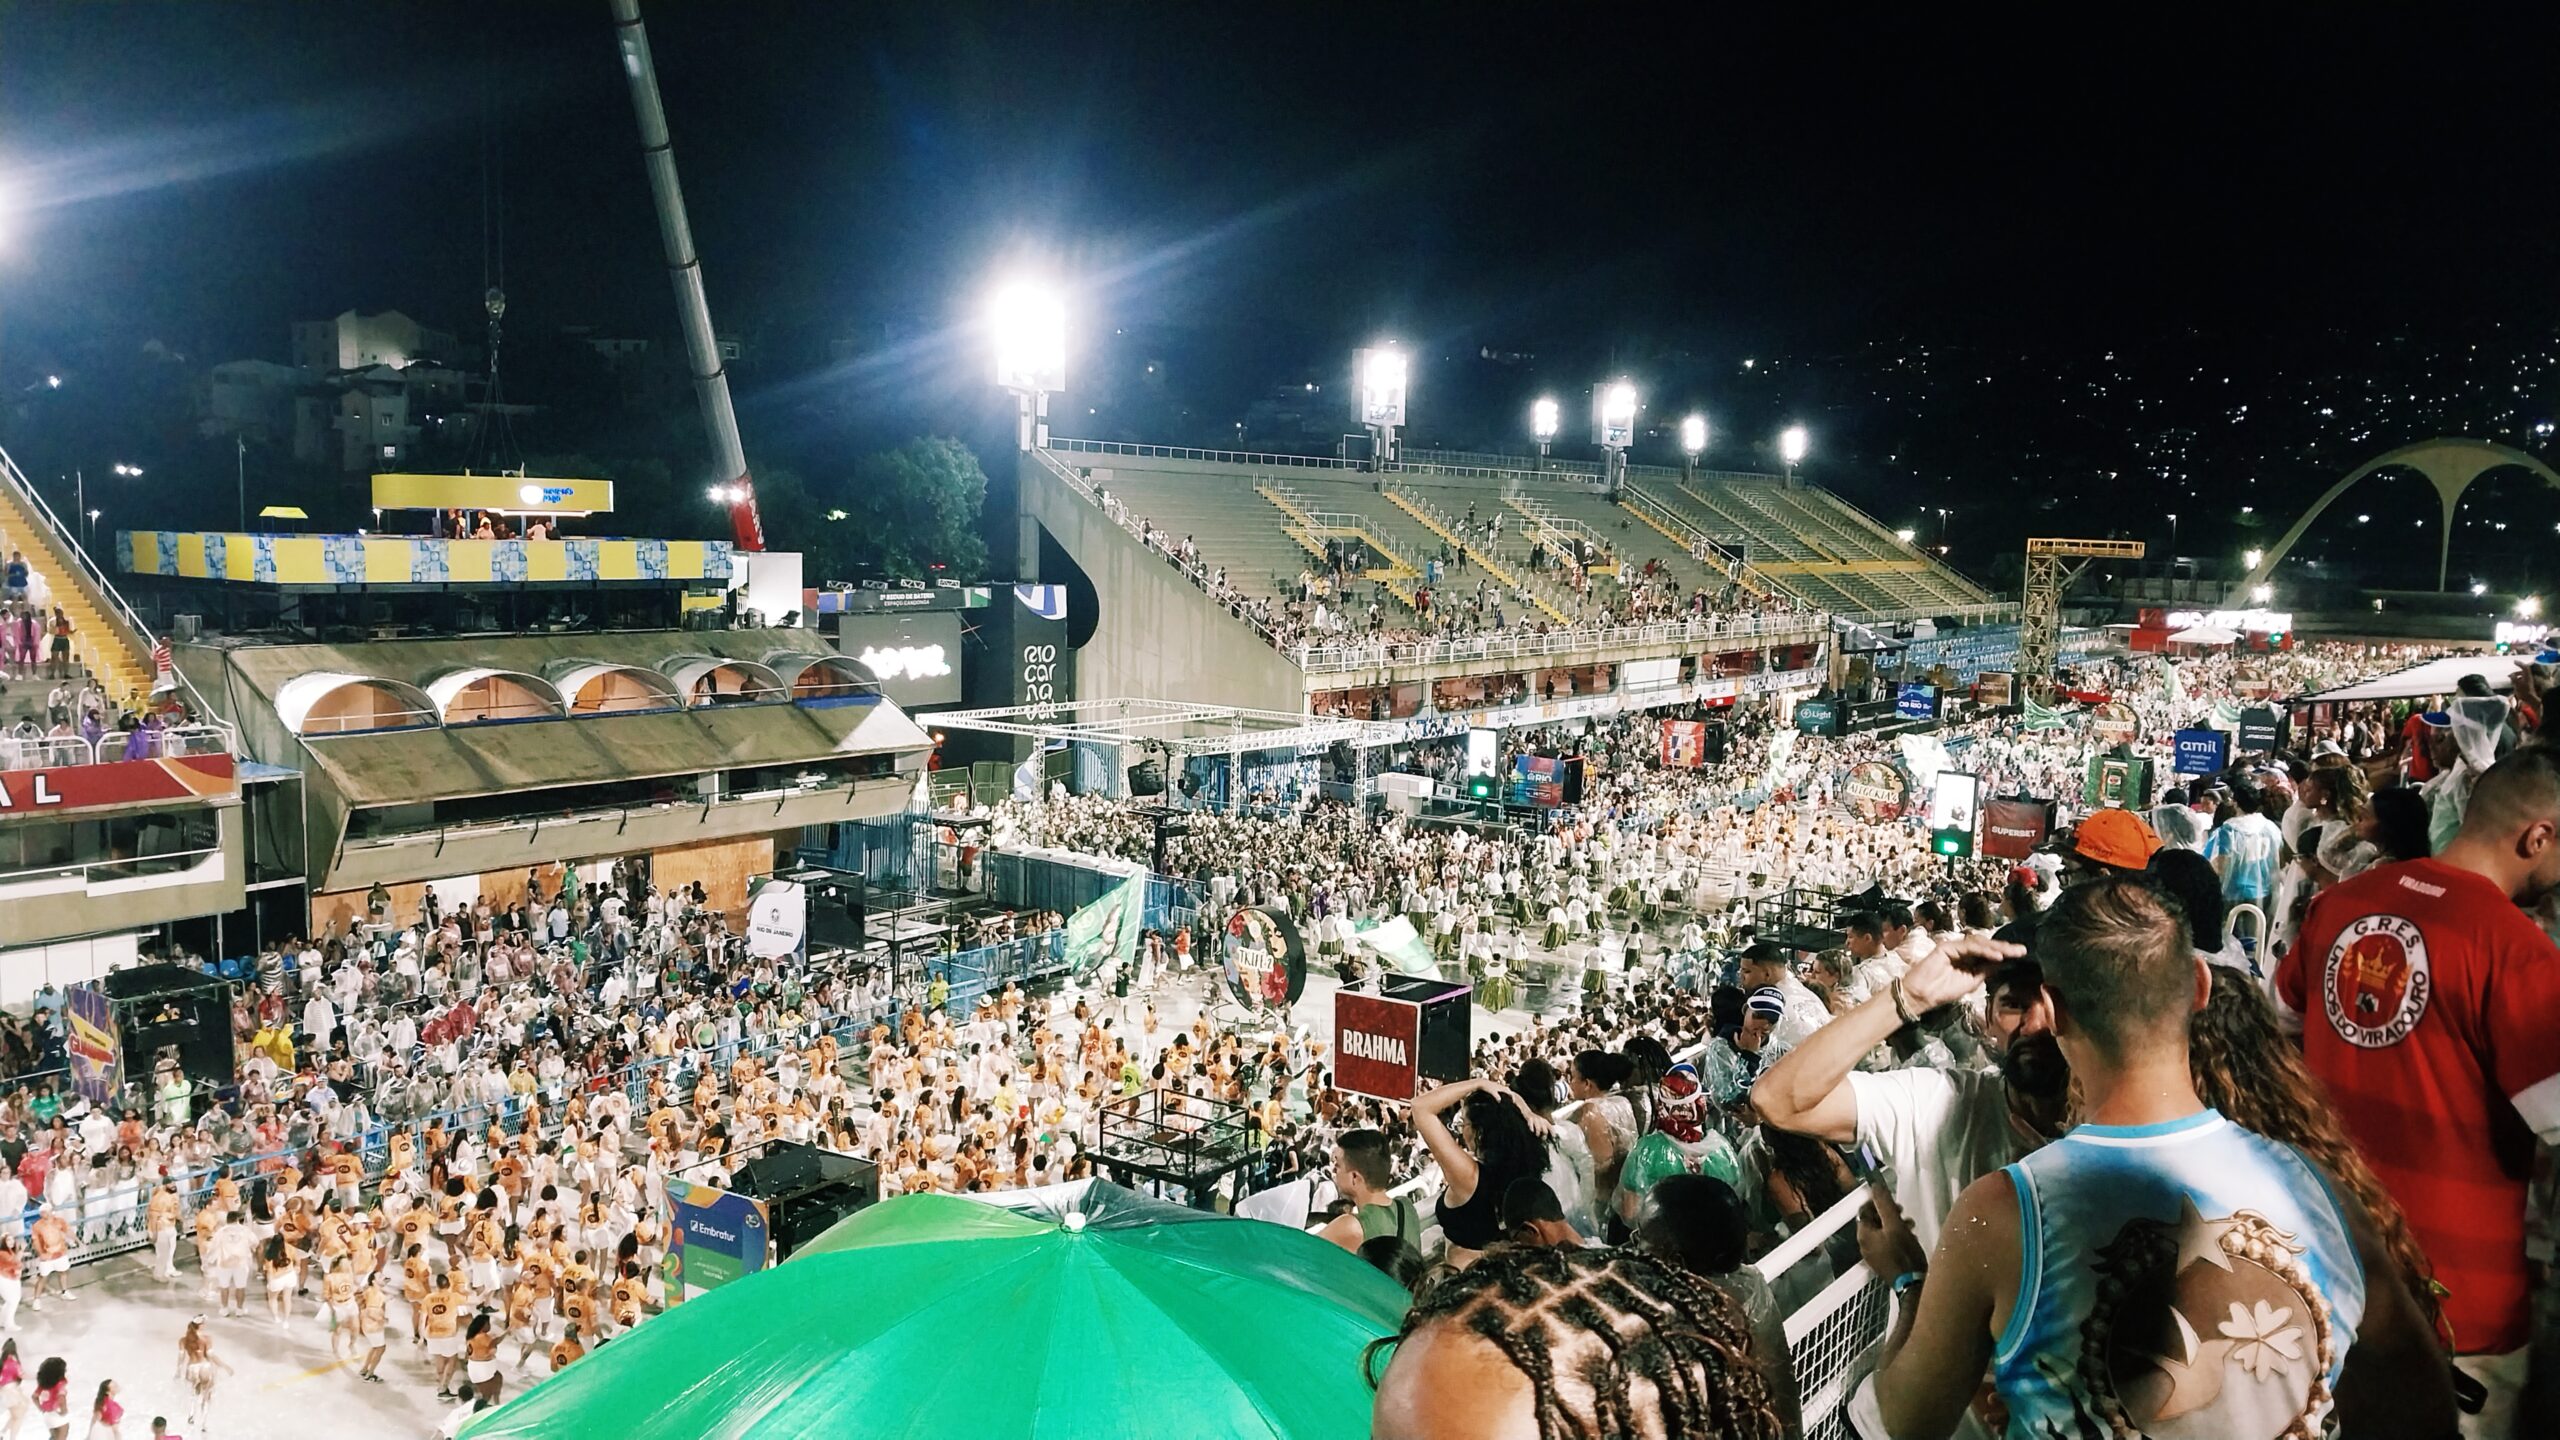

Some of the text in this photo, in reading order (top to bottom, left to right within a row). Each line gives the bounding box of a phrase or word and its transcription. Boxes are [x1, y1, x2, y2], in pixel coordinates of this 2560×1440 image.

[1812, 711, 1832, 719] Light
[2180, 740, 2217, 753] amil
[1535, 773, 1552, 783] RIO
[1991, 826, 2036, 837] SUPERBET
[773, 929, 794, 938] JANEIRO
[2354, 918, 2420, 954] G.R.E.S.
[2326, 945, 2427, 1045] UNIDOS DO VIRADOURO
[1343, 1029, 1407, 1066] BRAHMA
[699, 1223, 736, 1242] Embratur
